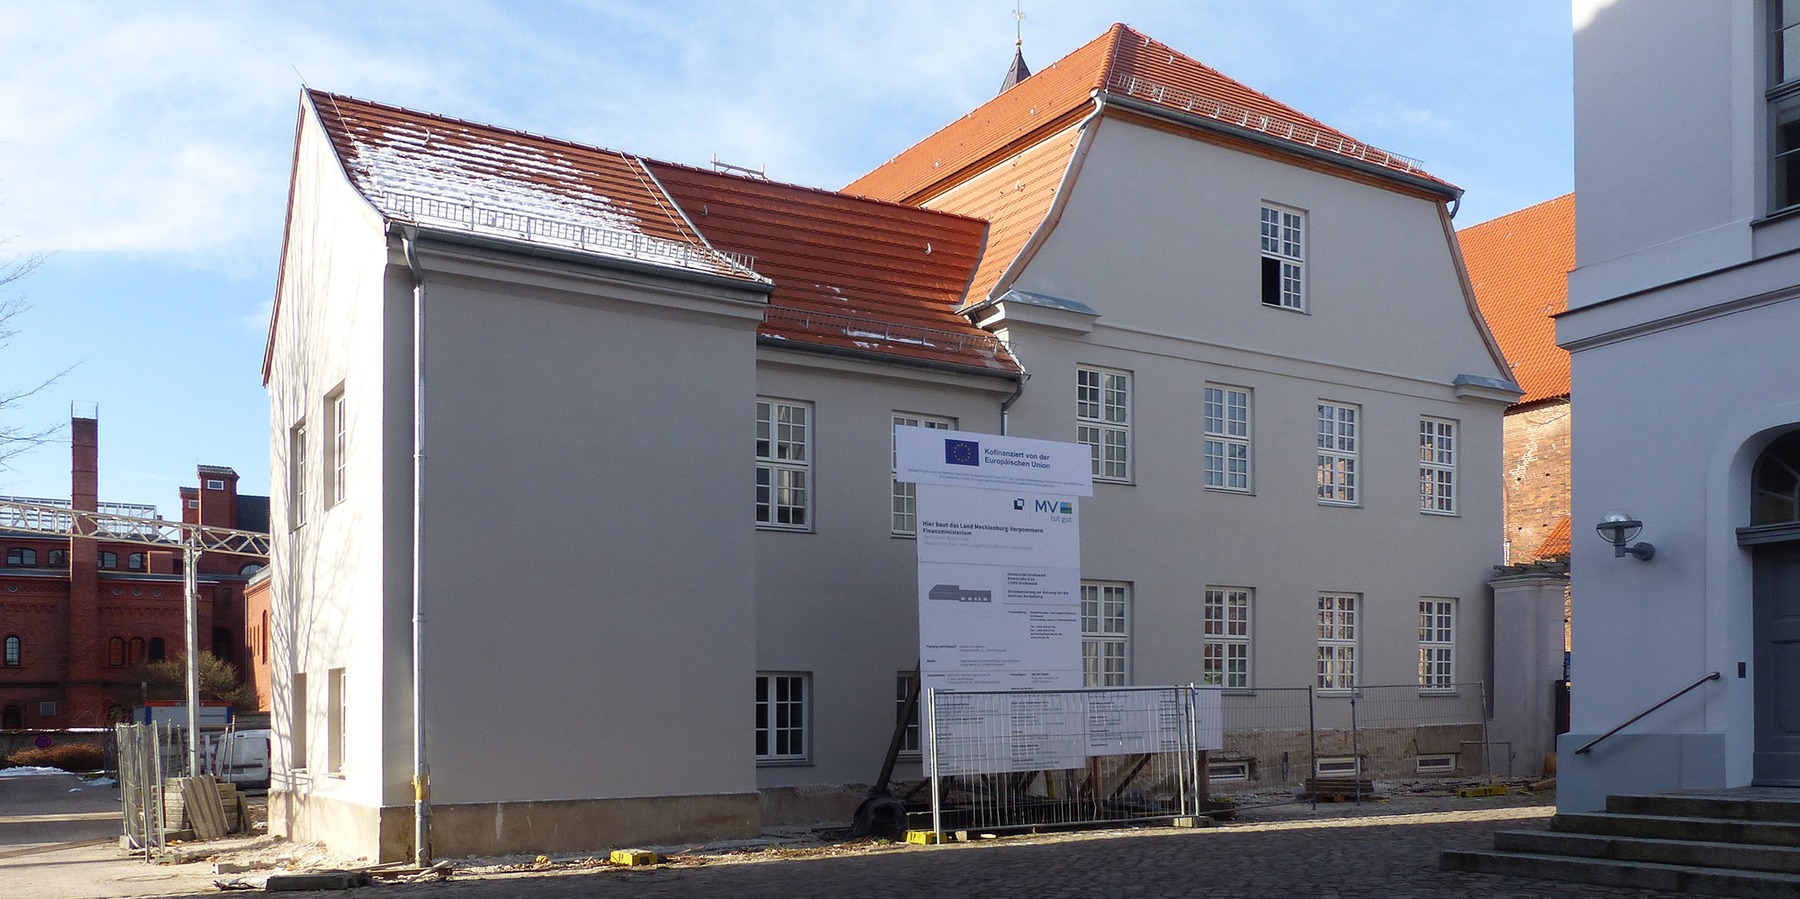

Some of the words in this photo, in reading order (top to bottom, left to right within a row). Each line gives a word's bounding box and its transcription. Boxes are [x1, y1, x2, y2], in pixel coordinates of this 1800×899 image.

[984, 447, 1025, 459] Kofinanziert
[984, 457, 1031, 468] Europäischen
[1031, 461, 1051, 470] Union
[1035, 499, 1059, 514] MV
[922, 528, 973, 536] Finanzministerium
[935, 521, 949, 529] baut
[949, 522, 960, 530] das
[974, 523, 1044, 534] Mecklenburg-Vorpommern
